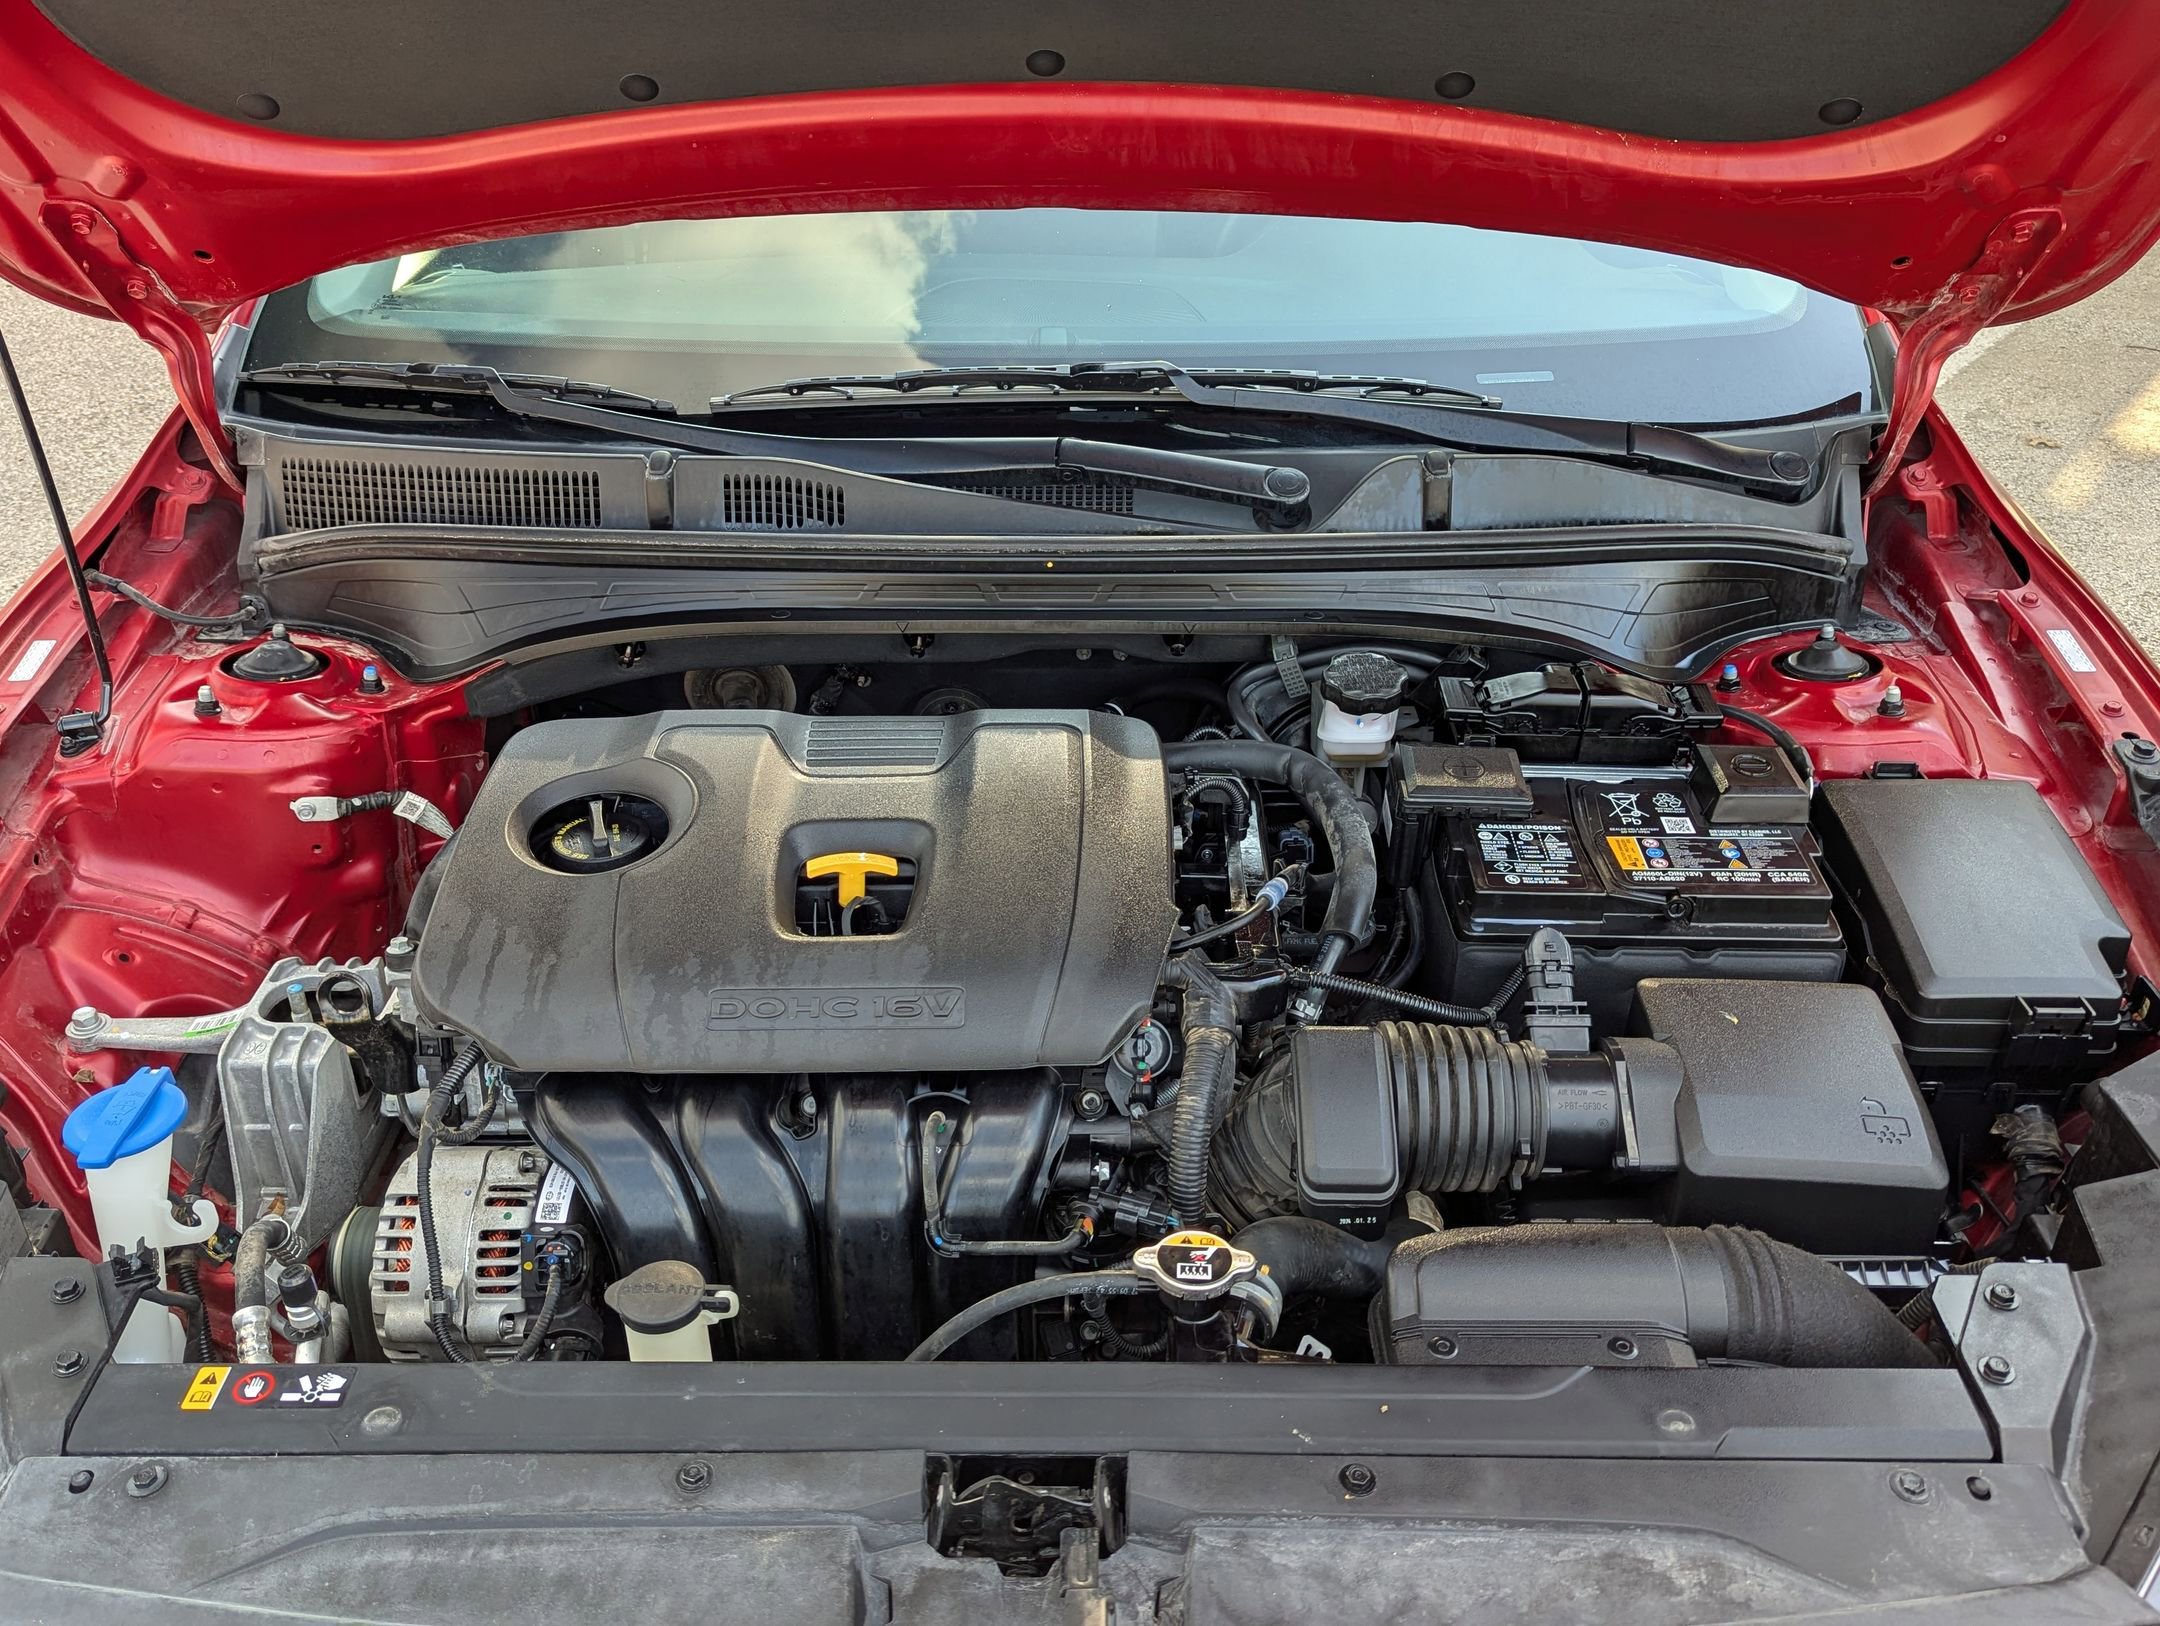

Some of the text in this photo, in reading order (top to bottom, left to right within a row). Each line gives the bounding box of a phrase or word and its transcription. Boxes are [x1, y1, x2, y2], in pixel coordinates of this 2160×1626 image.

[1621, 817, 1642, 825] Pb
[1486, 823, 1562, 831] DANGER/POISON
[709, 994, 963, 1019] DOHC 16V
